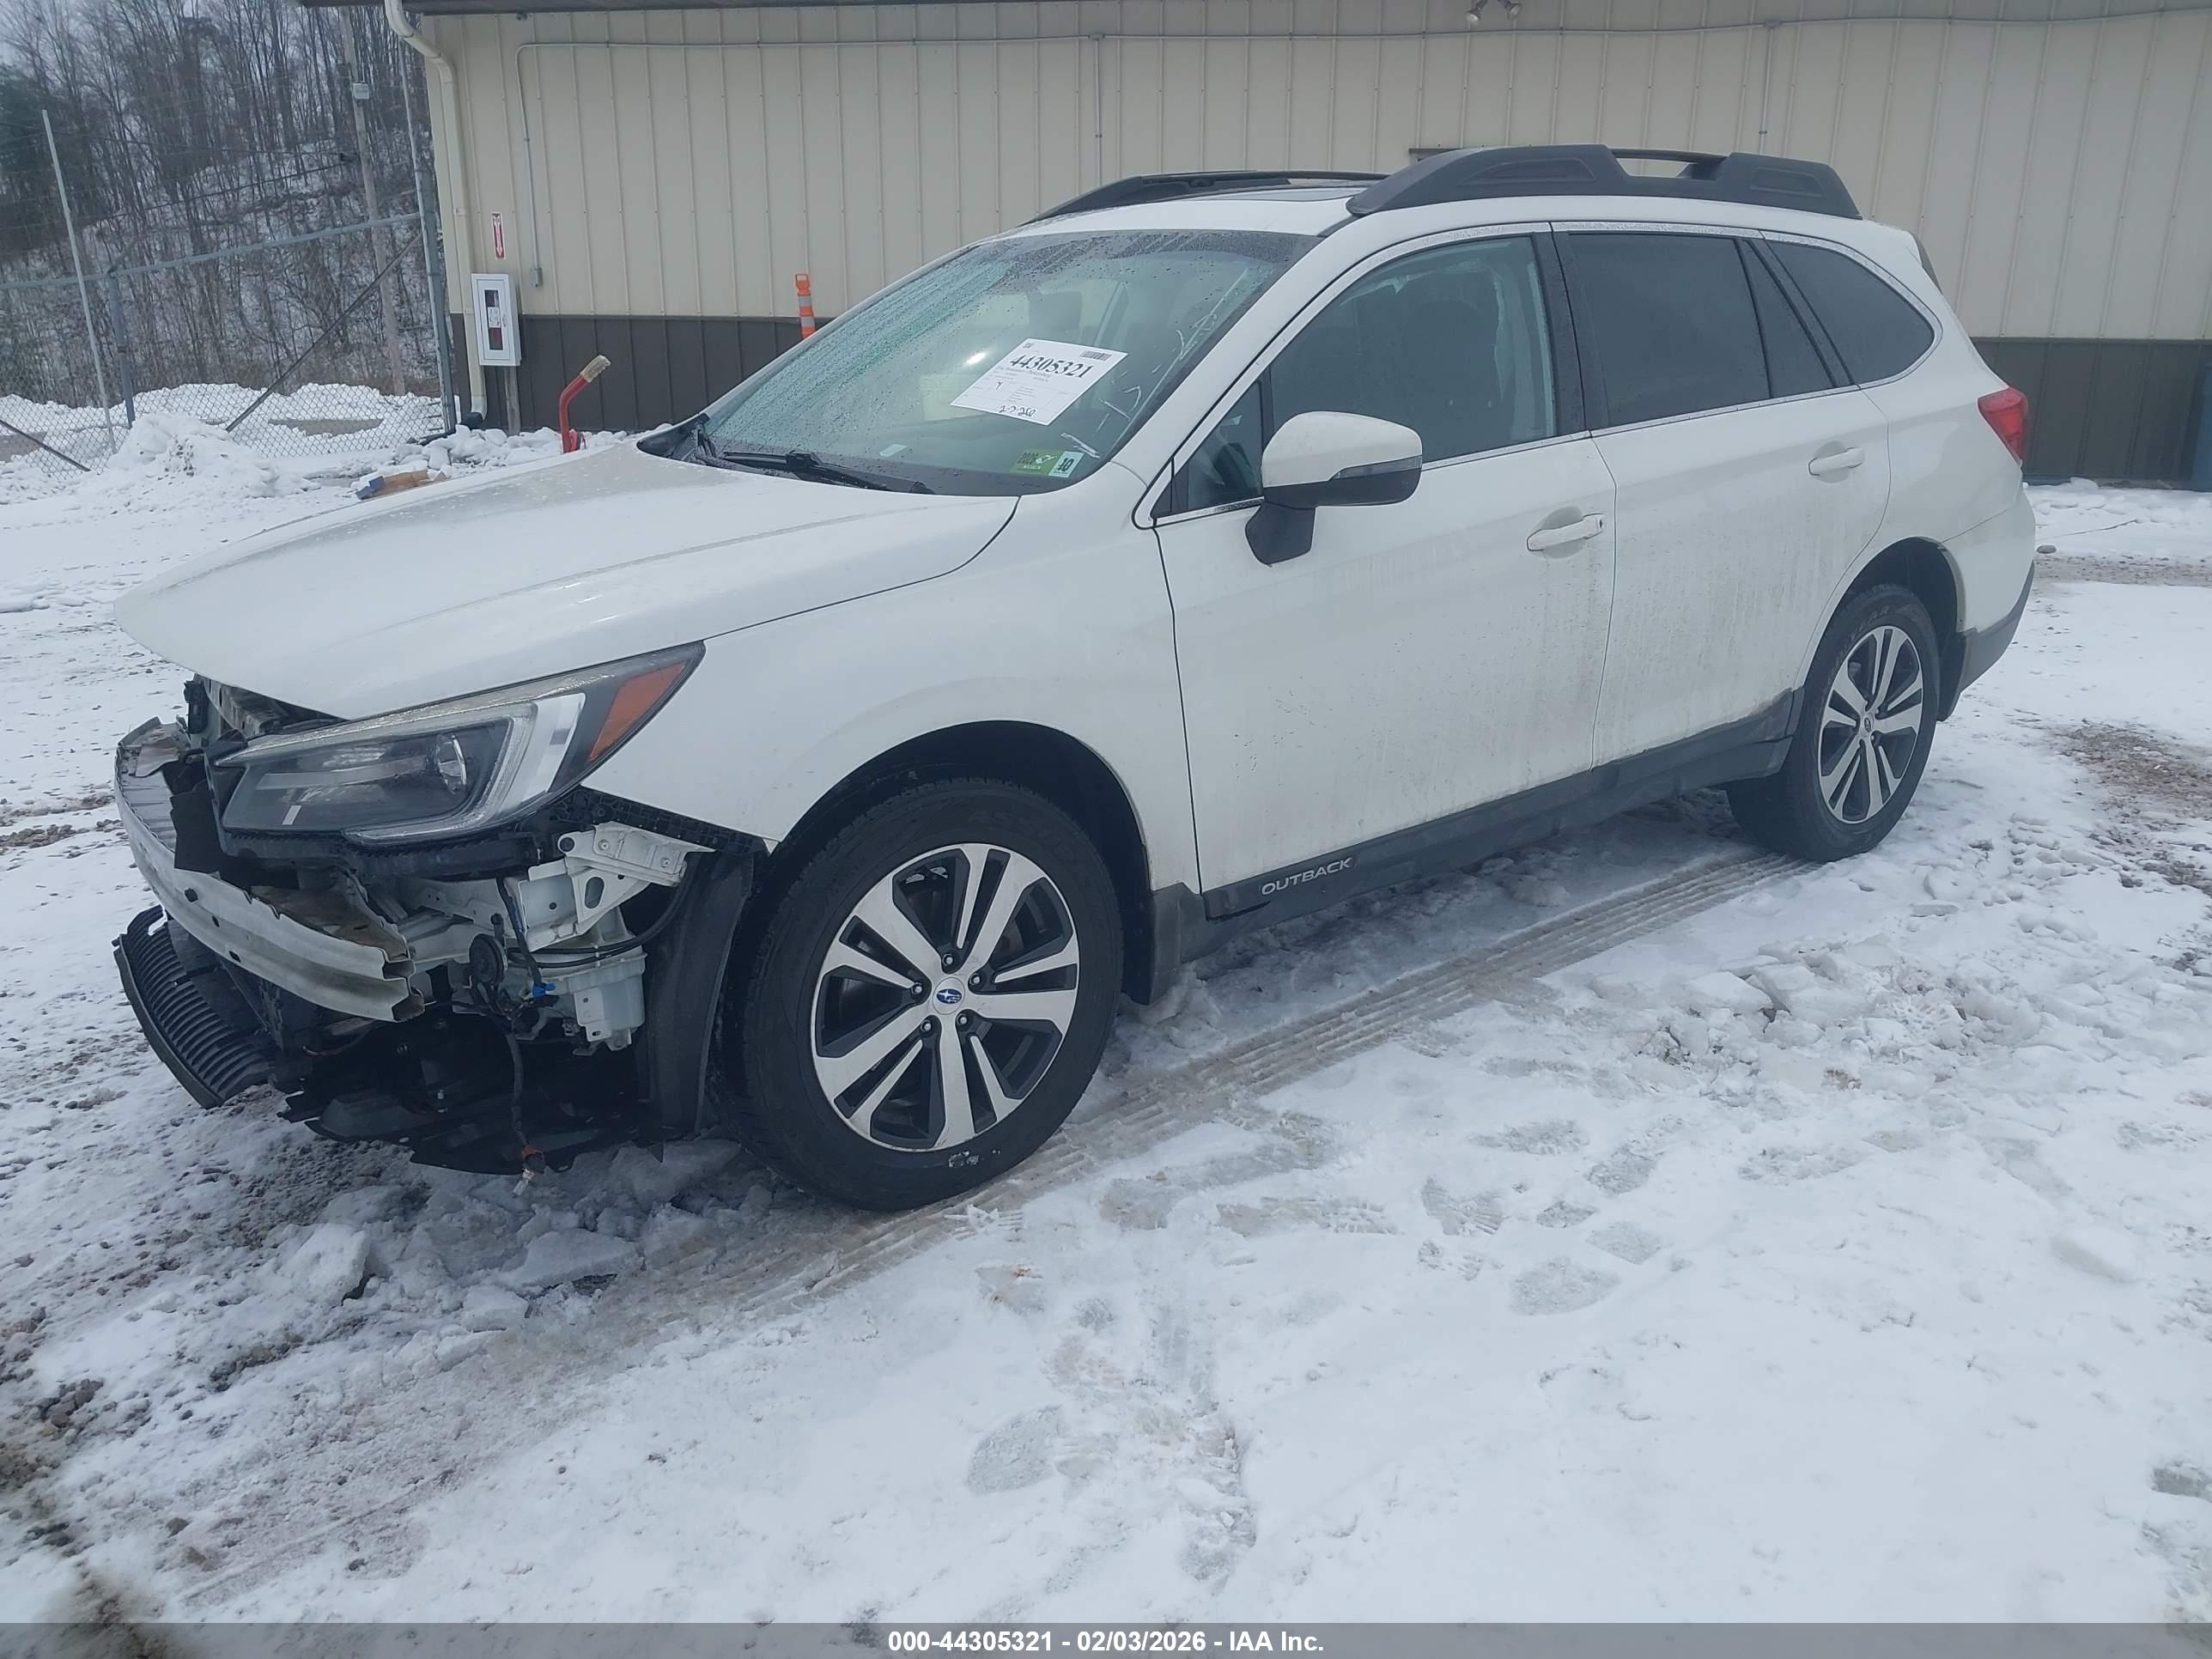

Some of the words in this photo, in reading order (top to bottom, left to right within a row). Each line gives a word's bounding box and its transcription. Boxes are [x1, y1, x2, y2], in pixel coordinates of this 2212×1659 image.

[1009, 353, 1093, 378] 44305321
[1057, 457, 1074, 472] 10
[1261, 857, 1352, 896] OUTBACK
